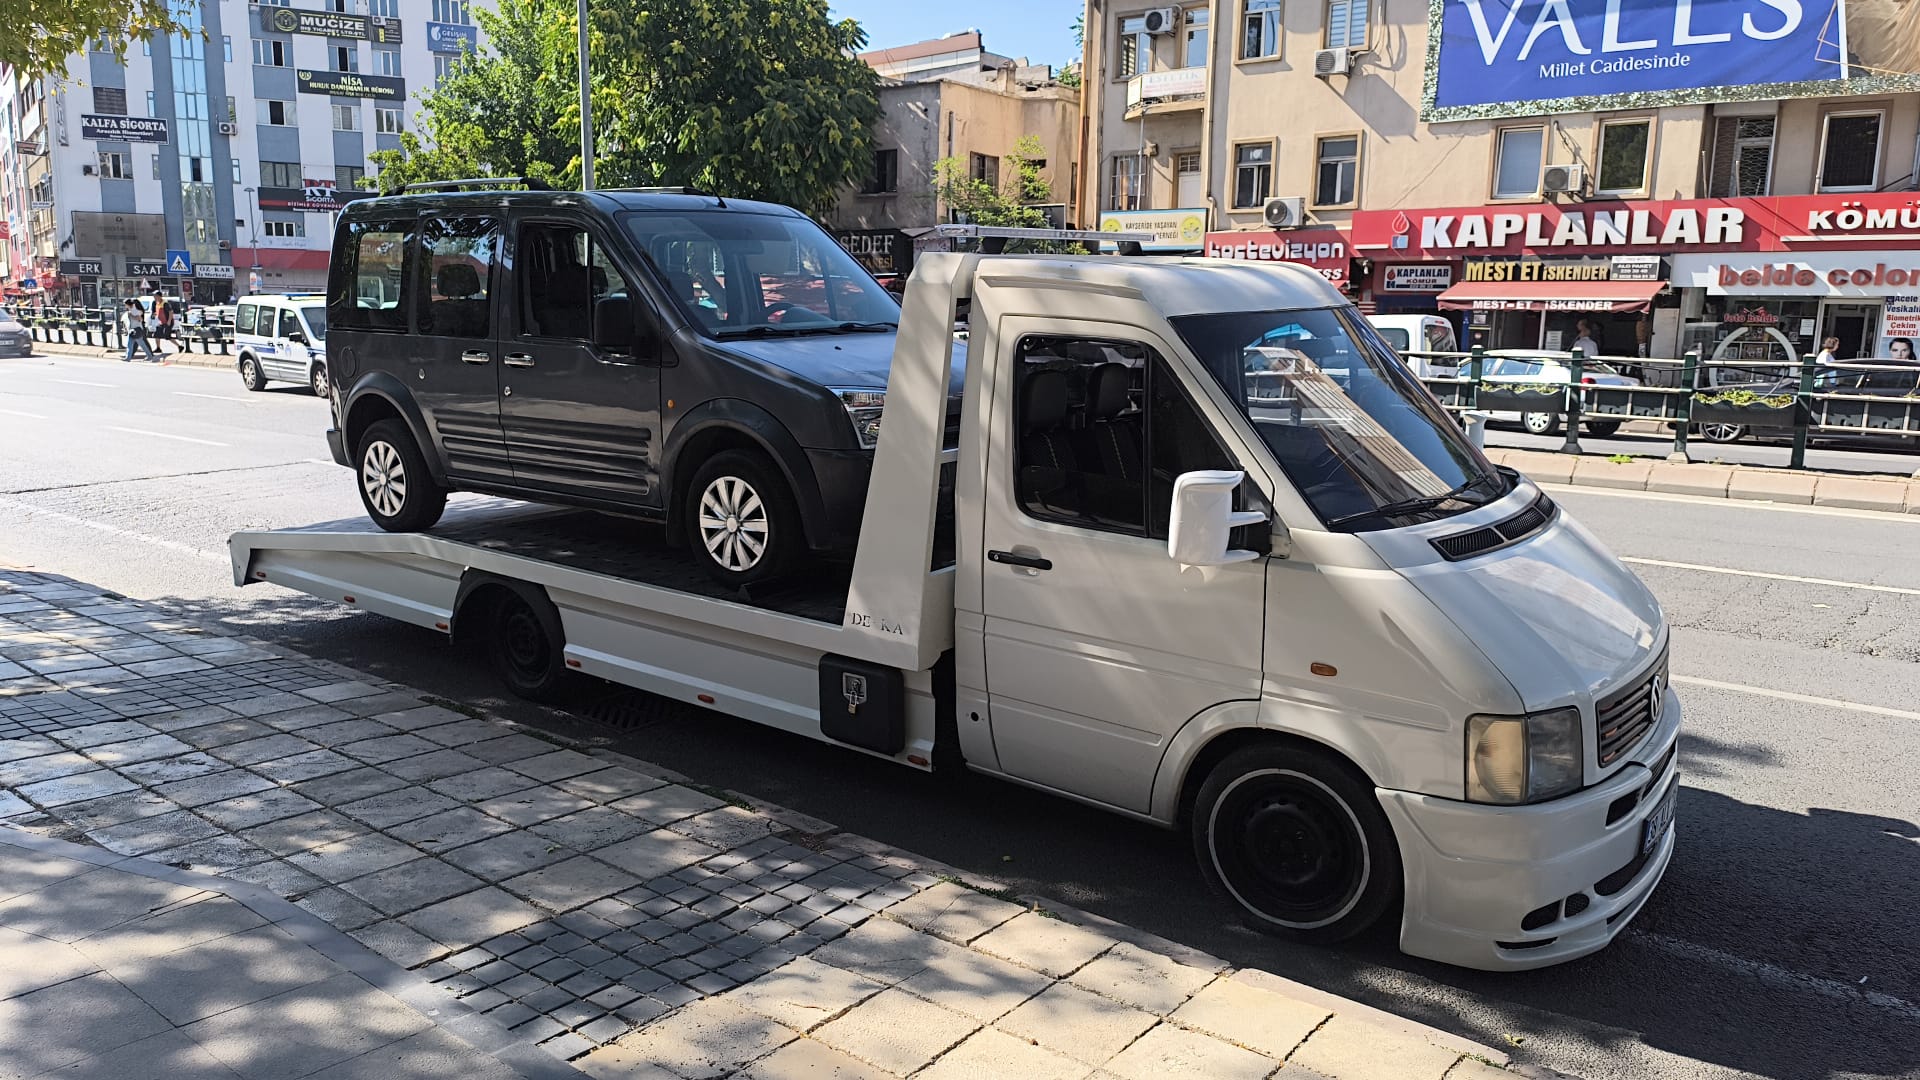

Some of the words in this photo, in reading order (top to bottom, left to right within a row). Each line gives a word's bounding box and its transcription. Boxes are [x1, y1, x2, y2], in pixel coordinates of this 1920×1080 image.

[1539, 62, 1586, 79] Millet
[1590, 53, 1691, 75] Caddesinde
[82, 118, 118, 129] KALFA
[120, 118, 167, 131] SİGORTA
[1421, 207, 1745, 248] KAPLANLAR
[840, 235, 894, 254] SEDEF
[133, 265, 162, 275] SAAT
[1397, 268, 1449, 277] KAPLANLAR
[1465, 261, 1516, 281] MEST
[1520, 261, 1542, 281] ET
[1718, 263, 1815, 286] belde
